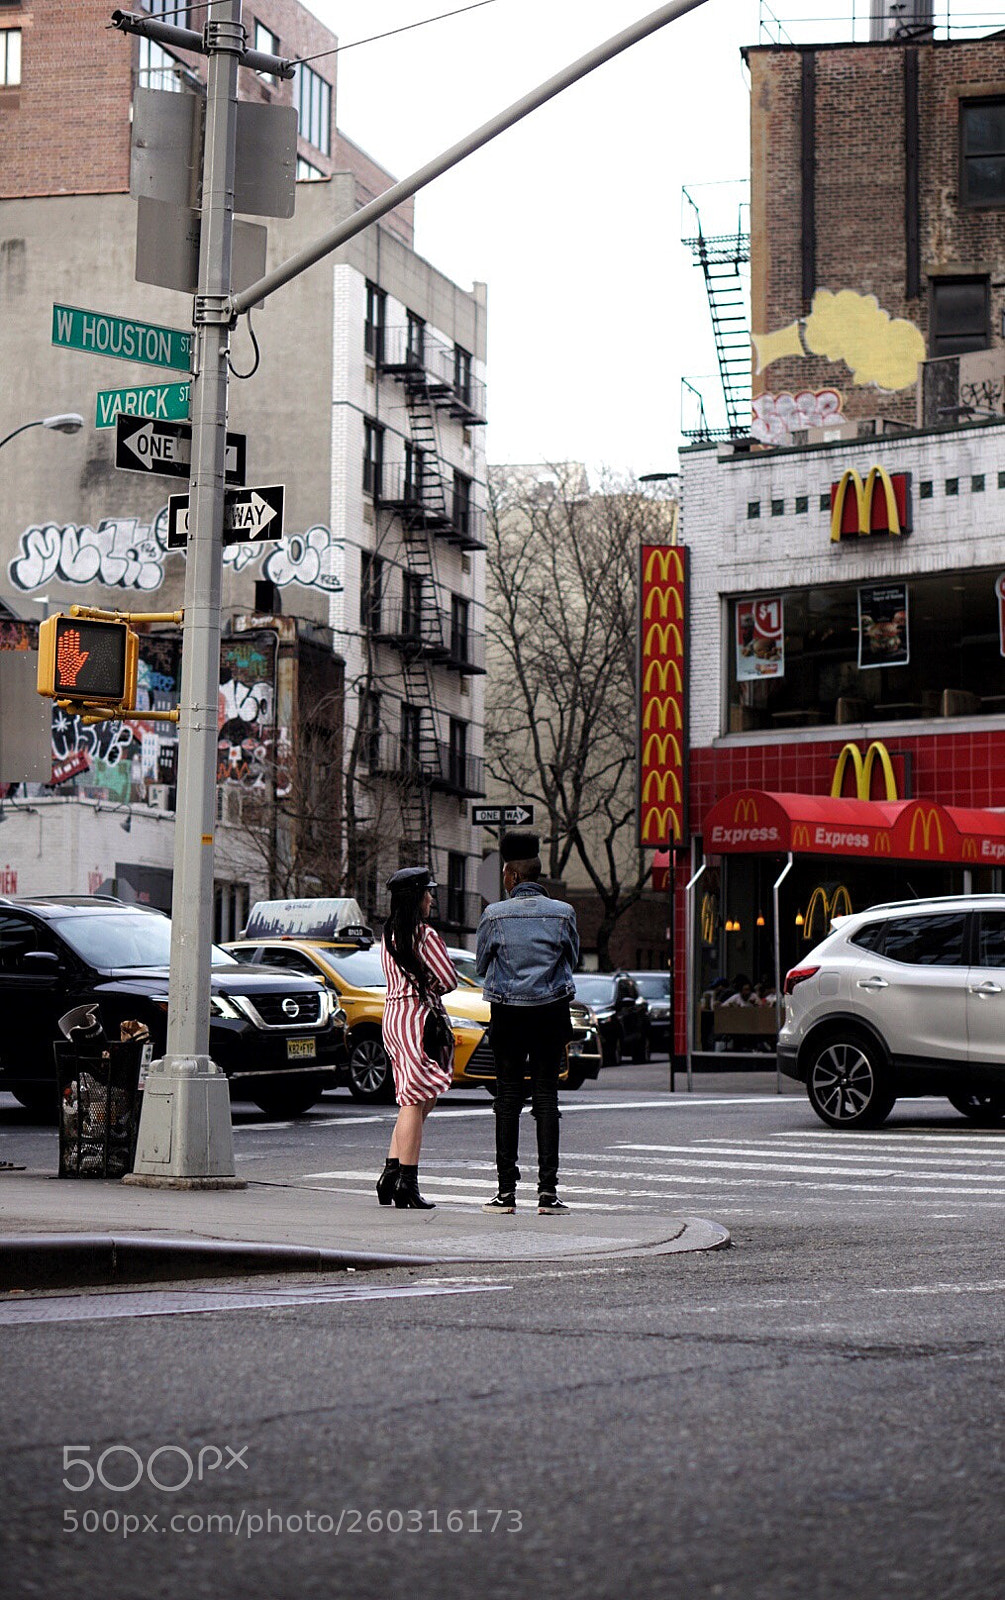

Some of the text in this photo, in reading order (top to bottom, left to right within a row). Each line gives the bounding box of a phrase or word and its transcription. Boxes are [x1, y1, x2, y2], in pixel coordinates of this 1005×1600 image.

[57, 309, 73, 343] W
[82, 318, 172, 364] HOUSTON
[100, 385, 190, 424] VARICK ST
[137, 434, 174, 459] ONE
[232, 505, 266, 527] WAY
[759, 602, 779, 628] $1
[480, 811, 524, 820] ONE WAY
[711, 825, 778, 845] Express
[815, 827, 869, 848] Express
